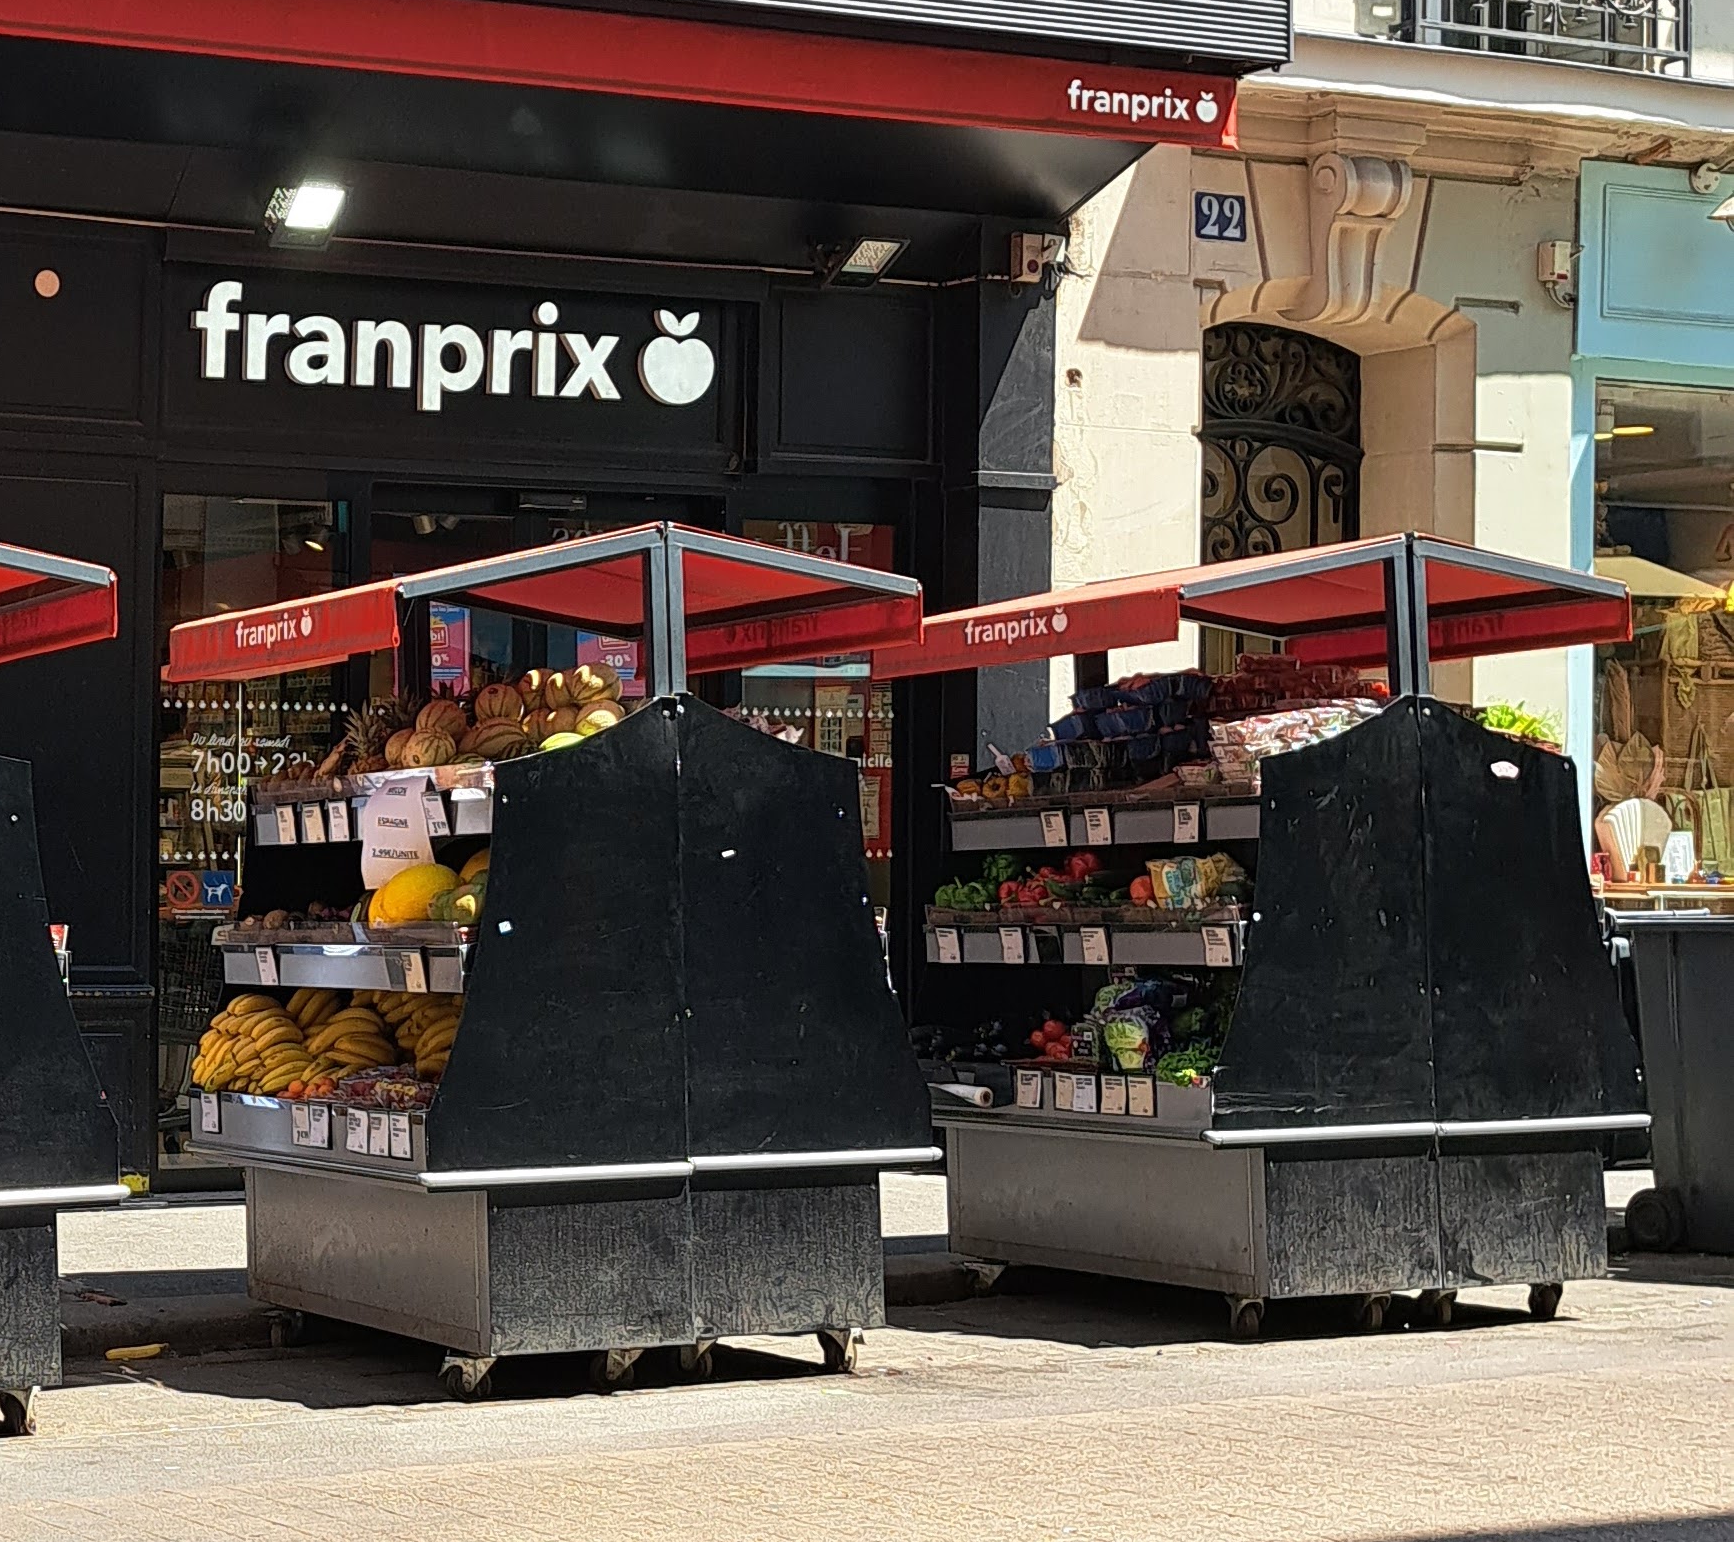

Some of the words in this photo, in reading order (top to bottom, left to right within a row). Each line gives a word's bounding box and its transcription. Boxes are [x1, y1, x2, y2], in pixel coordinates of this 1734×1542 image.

[1067, 78, 1191, 123] franprix
[1200, 195, 1242, 238] 22
[190, 280, 622, 412] franprix
[235, 611, 297, 649] franprix
[965, 610, 1049, 645] franprix
[190, 749, 251, 775] 7h00
[190, 798, 247, 823] 8h30
